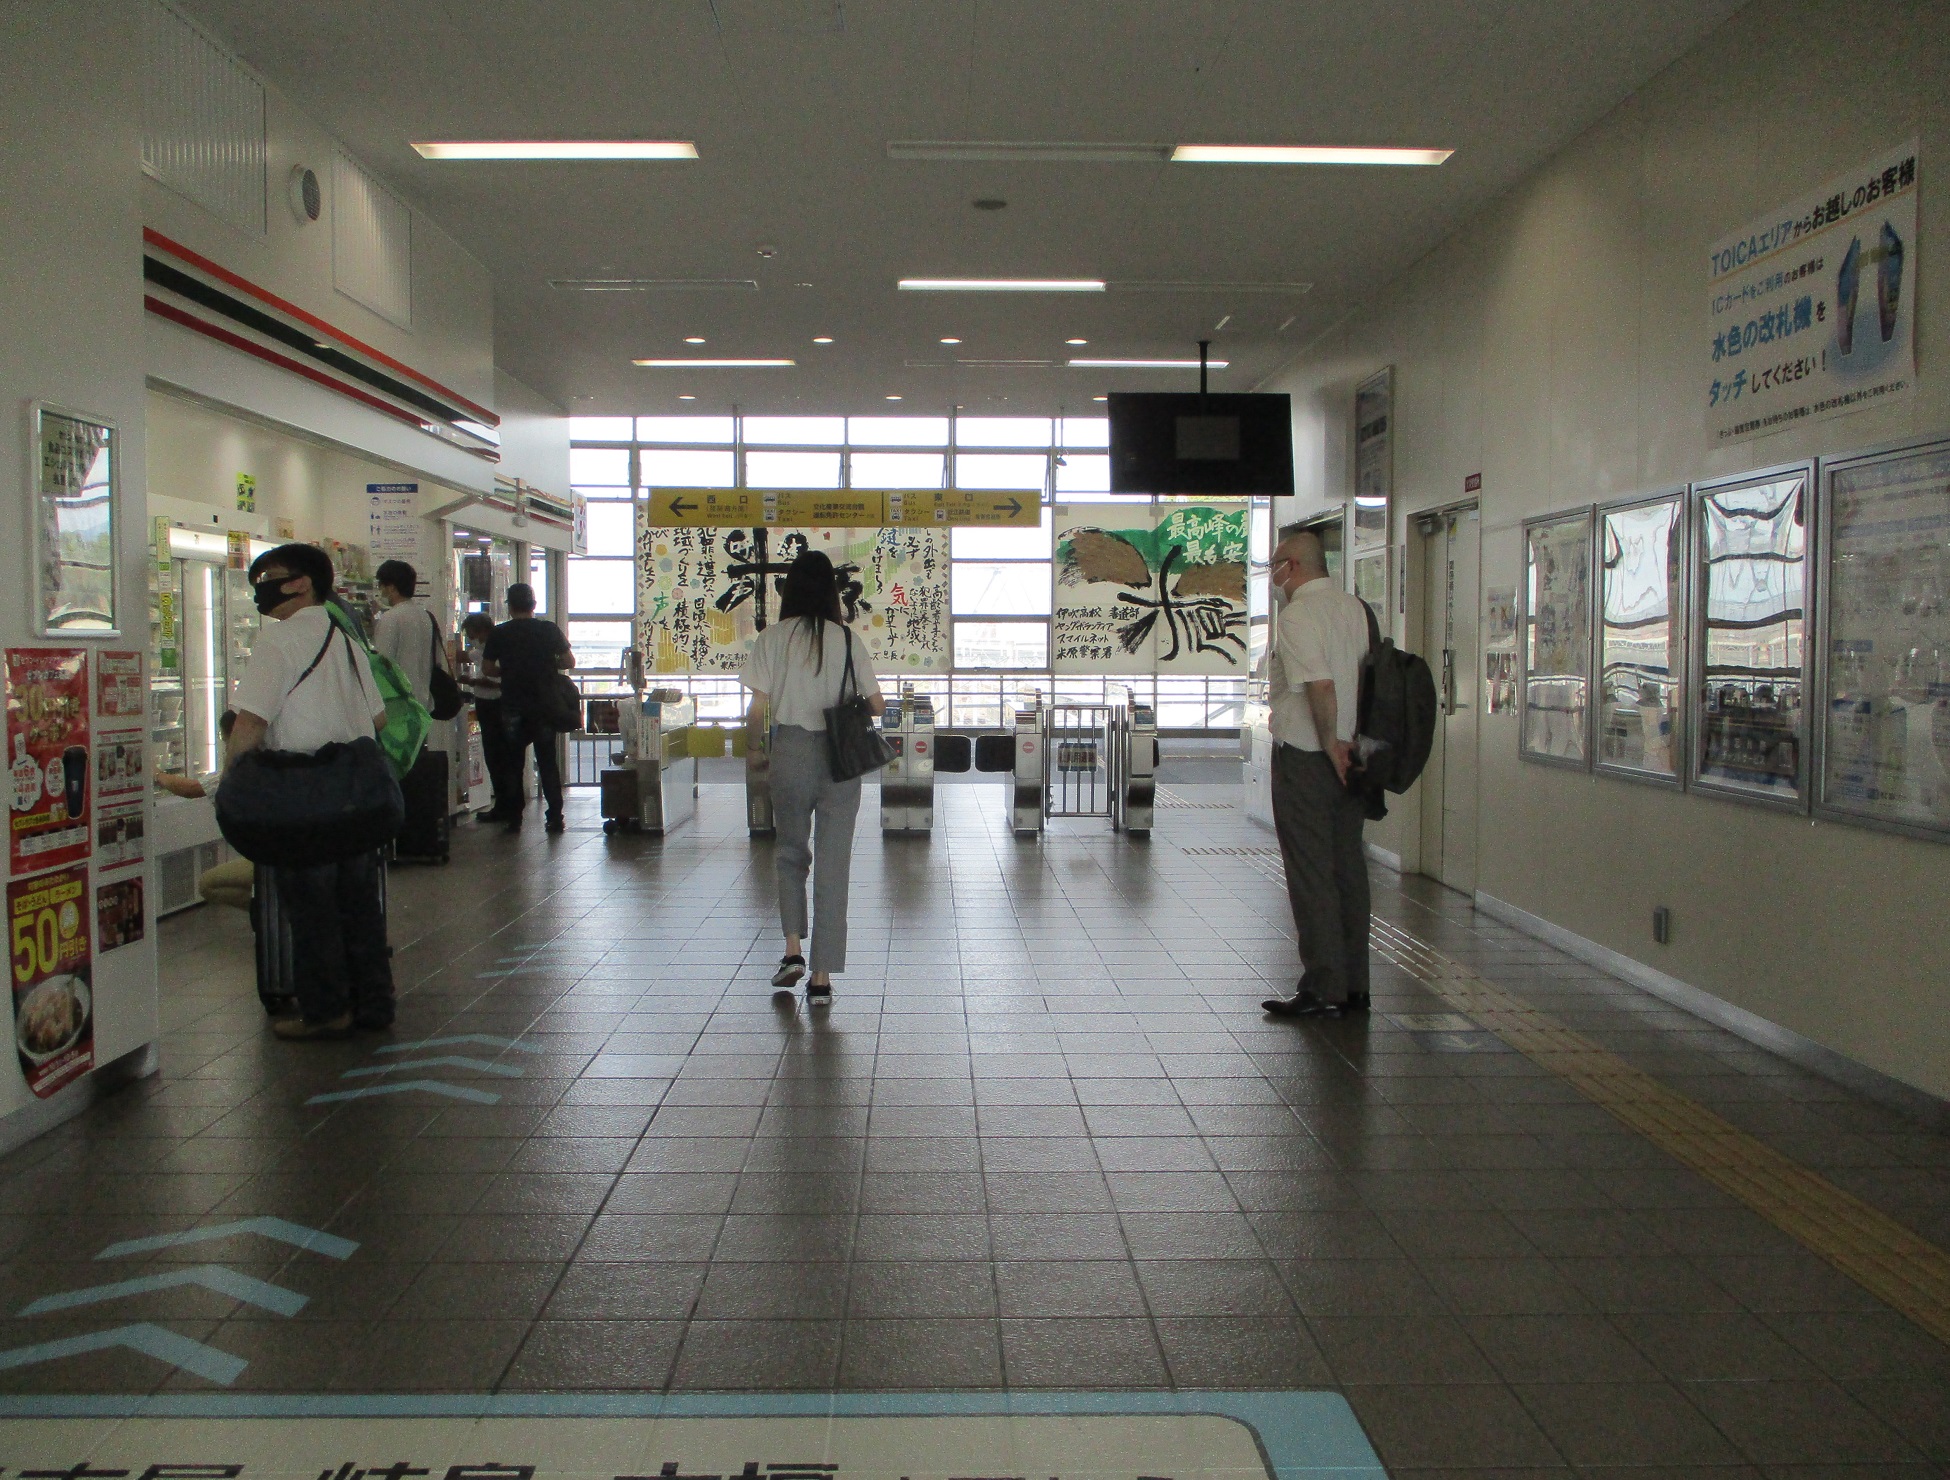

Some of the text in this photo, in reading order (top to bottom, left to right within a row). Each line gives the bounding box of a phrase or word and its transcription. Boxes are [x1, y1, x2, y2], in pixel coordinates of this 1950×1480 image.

[1711, 155, 1915, 277] TOICAエリアからお越しのお客様
[1711, 295, 1826, 363] 水色の改札機を
[923, 527, 939, 580] しの外出でも
[1182, 541, 1248, 566] 最も安
[672, 597, 691, 654] 積極的に
[1054, 606, 1103, 620] 伊吹高校
[1055, 632, 1110, 645] スマイルネット
